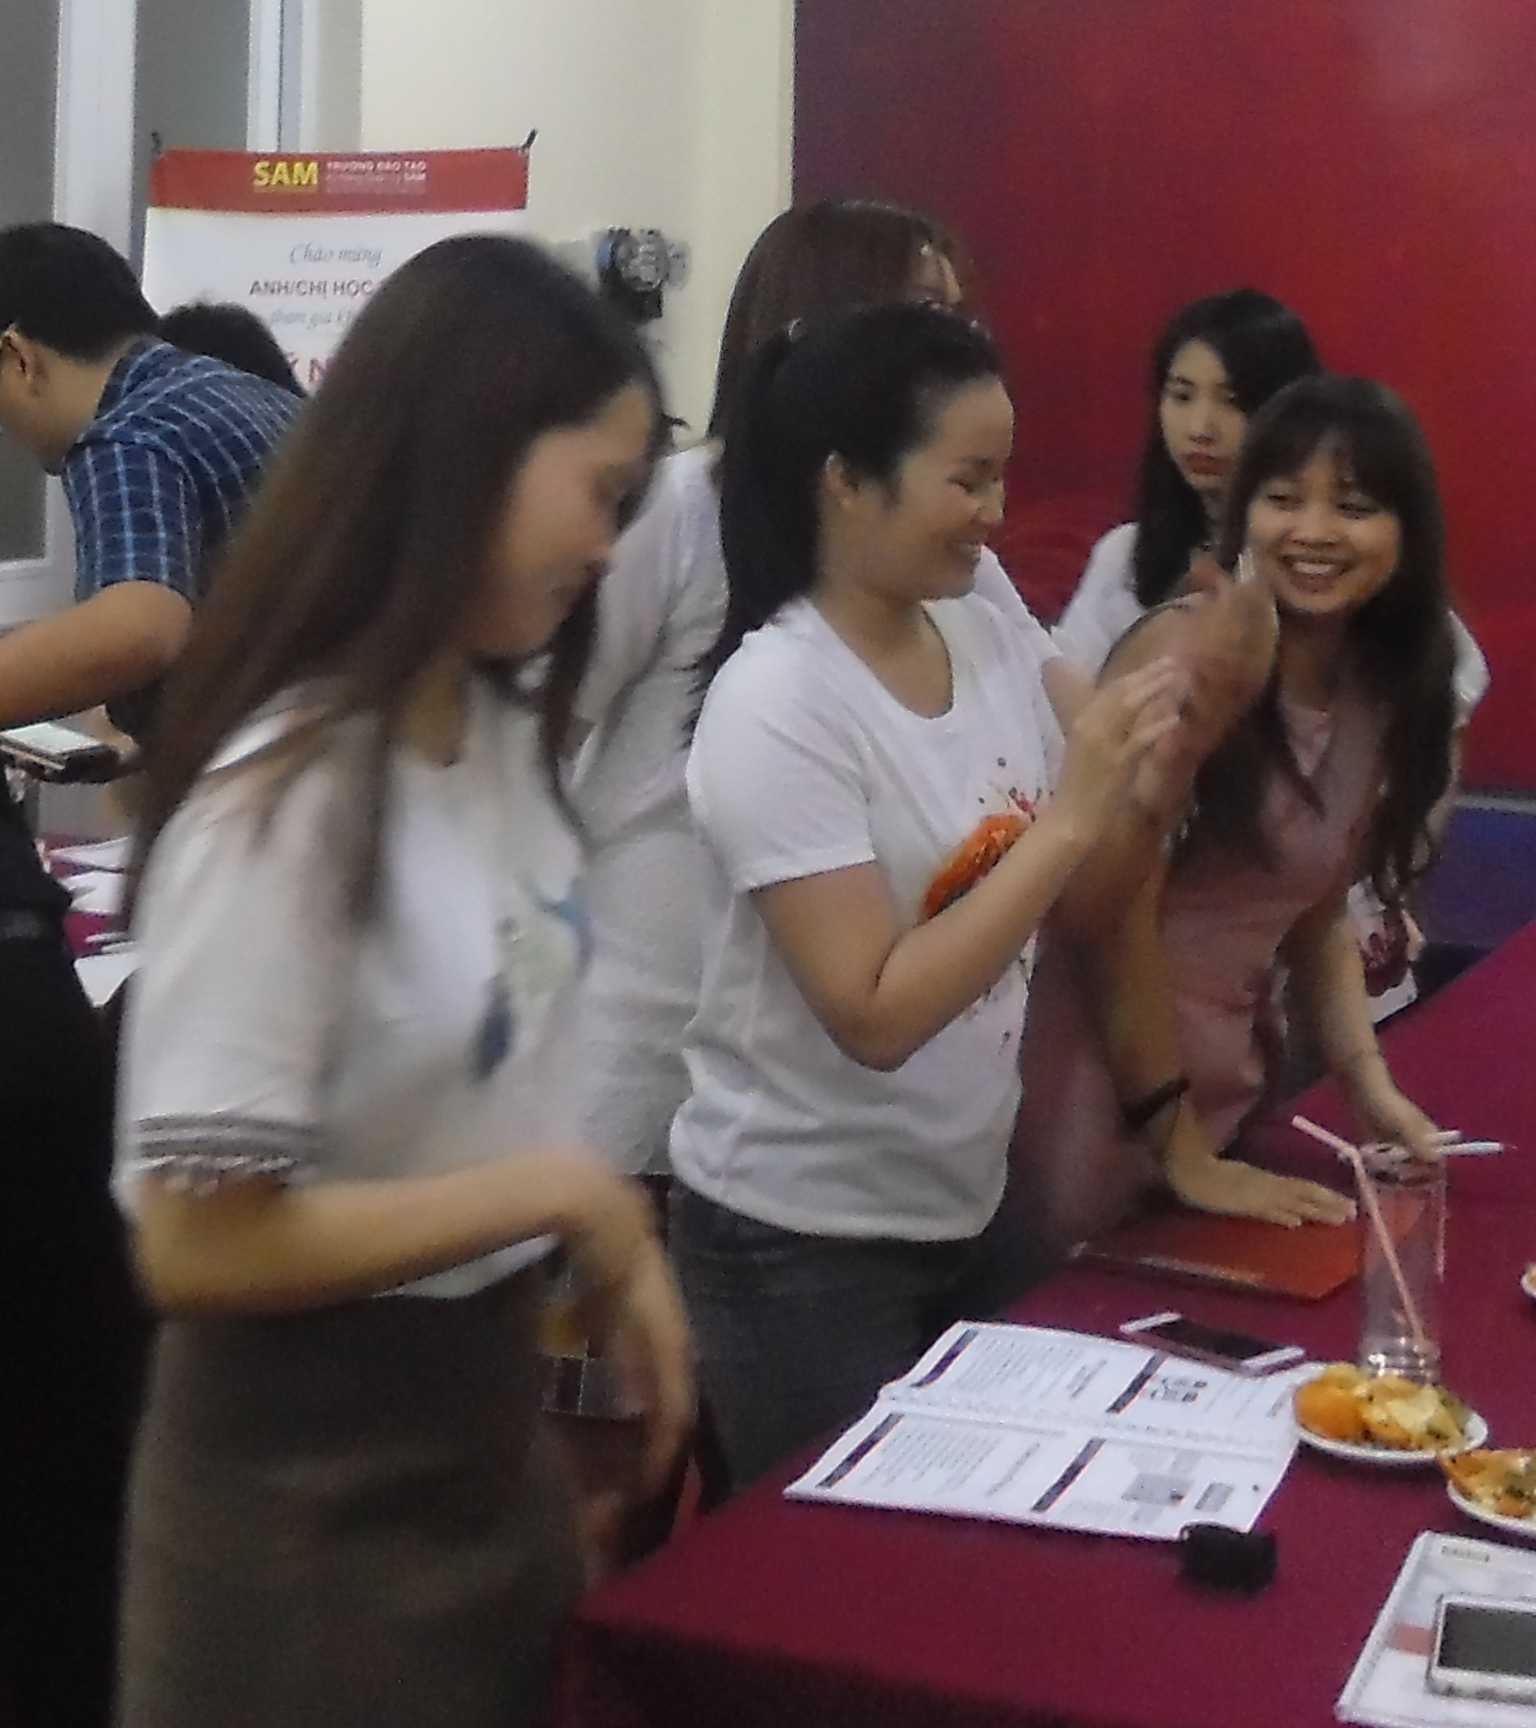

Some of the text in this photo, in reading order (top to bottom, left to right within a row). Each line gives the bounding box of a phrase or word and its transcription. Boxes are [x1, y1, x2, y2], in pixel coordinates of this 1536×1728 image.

[253, 160, 319, 186] SAM
[249, 279, 374, 298] ANH/CHỊ HỌC
